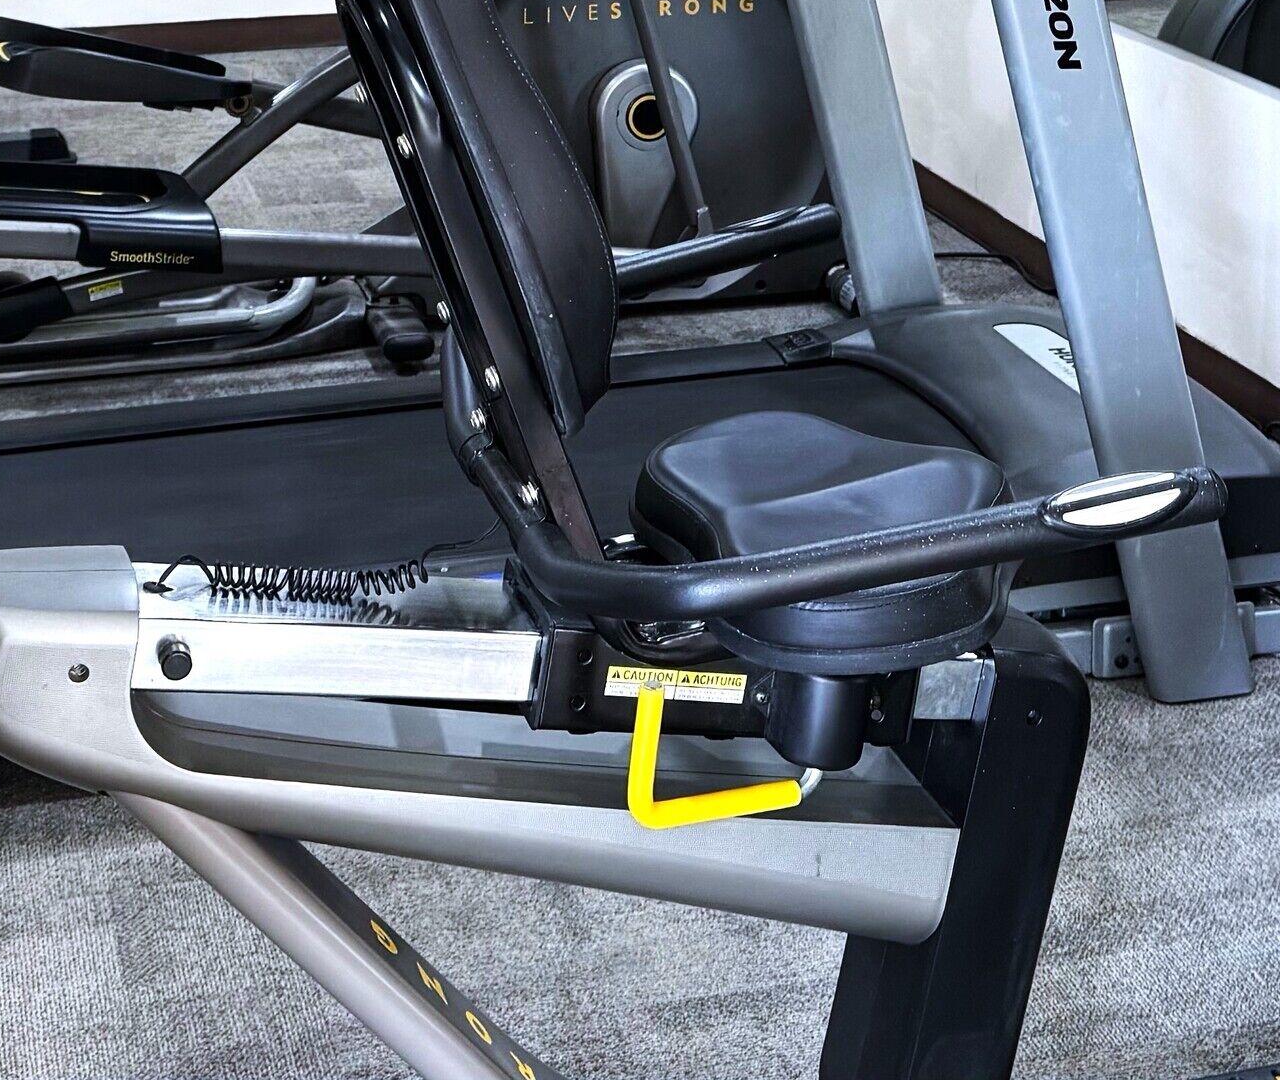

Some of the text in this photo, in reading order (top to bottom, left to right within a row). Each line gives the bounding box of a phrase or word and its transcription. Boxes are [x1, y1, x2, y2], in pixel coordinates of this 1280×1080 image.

[109, 250, 191, 265] SmoothStride
[623, 670, 674, 683] CAUTION
[693, 674, 742, 687] ACHTUNG
